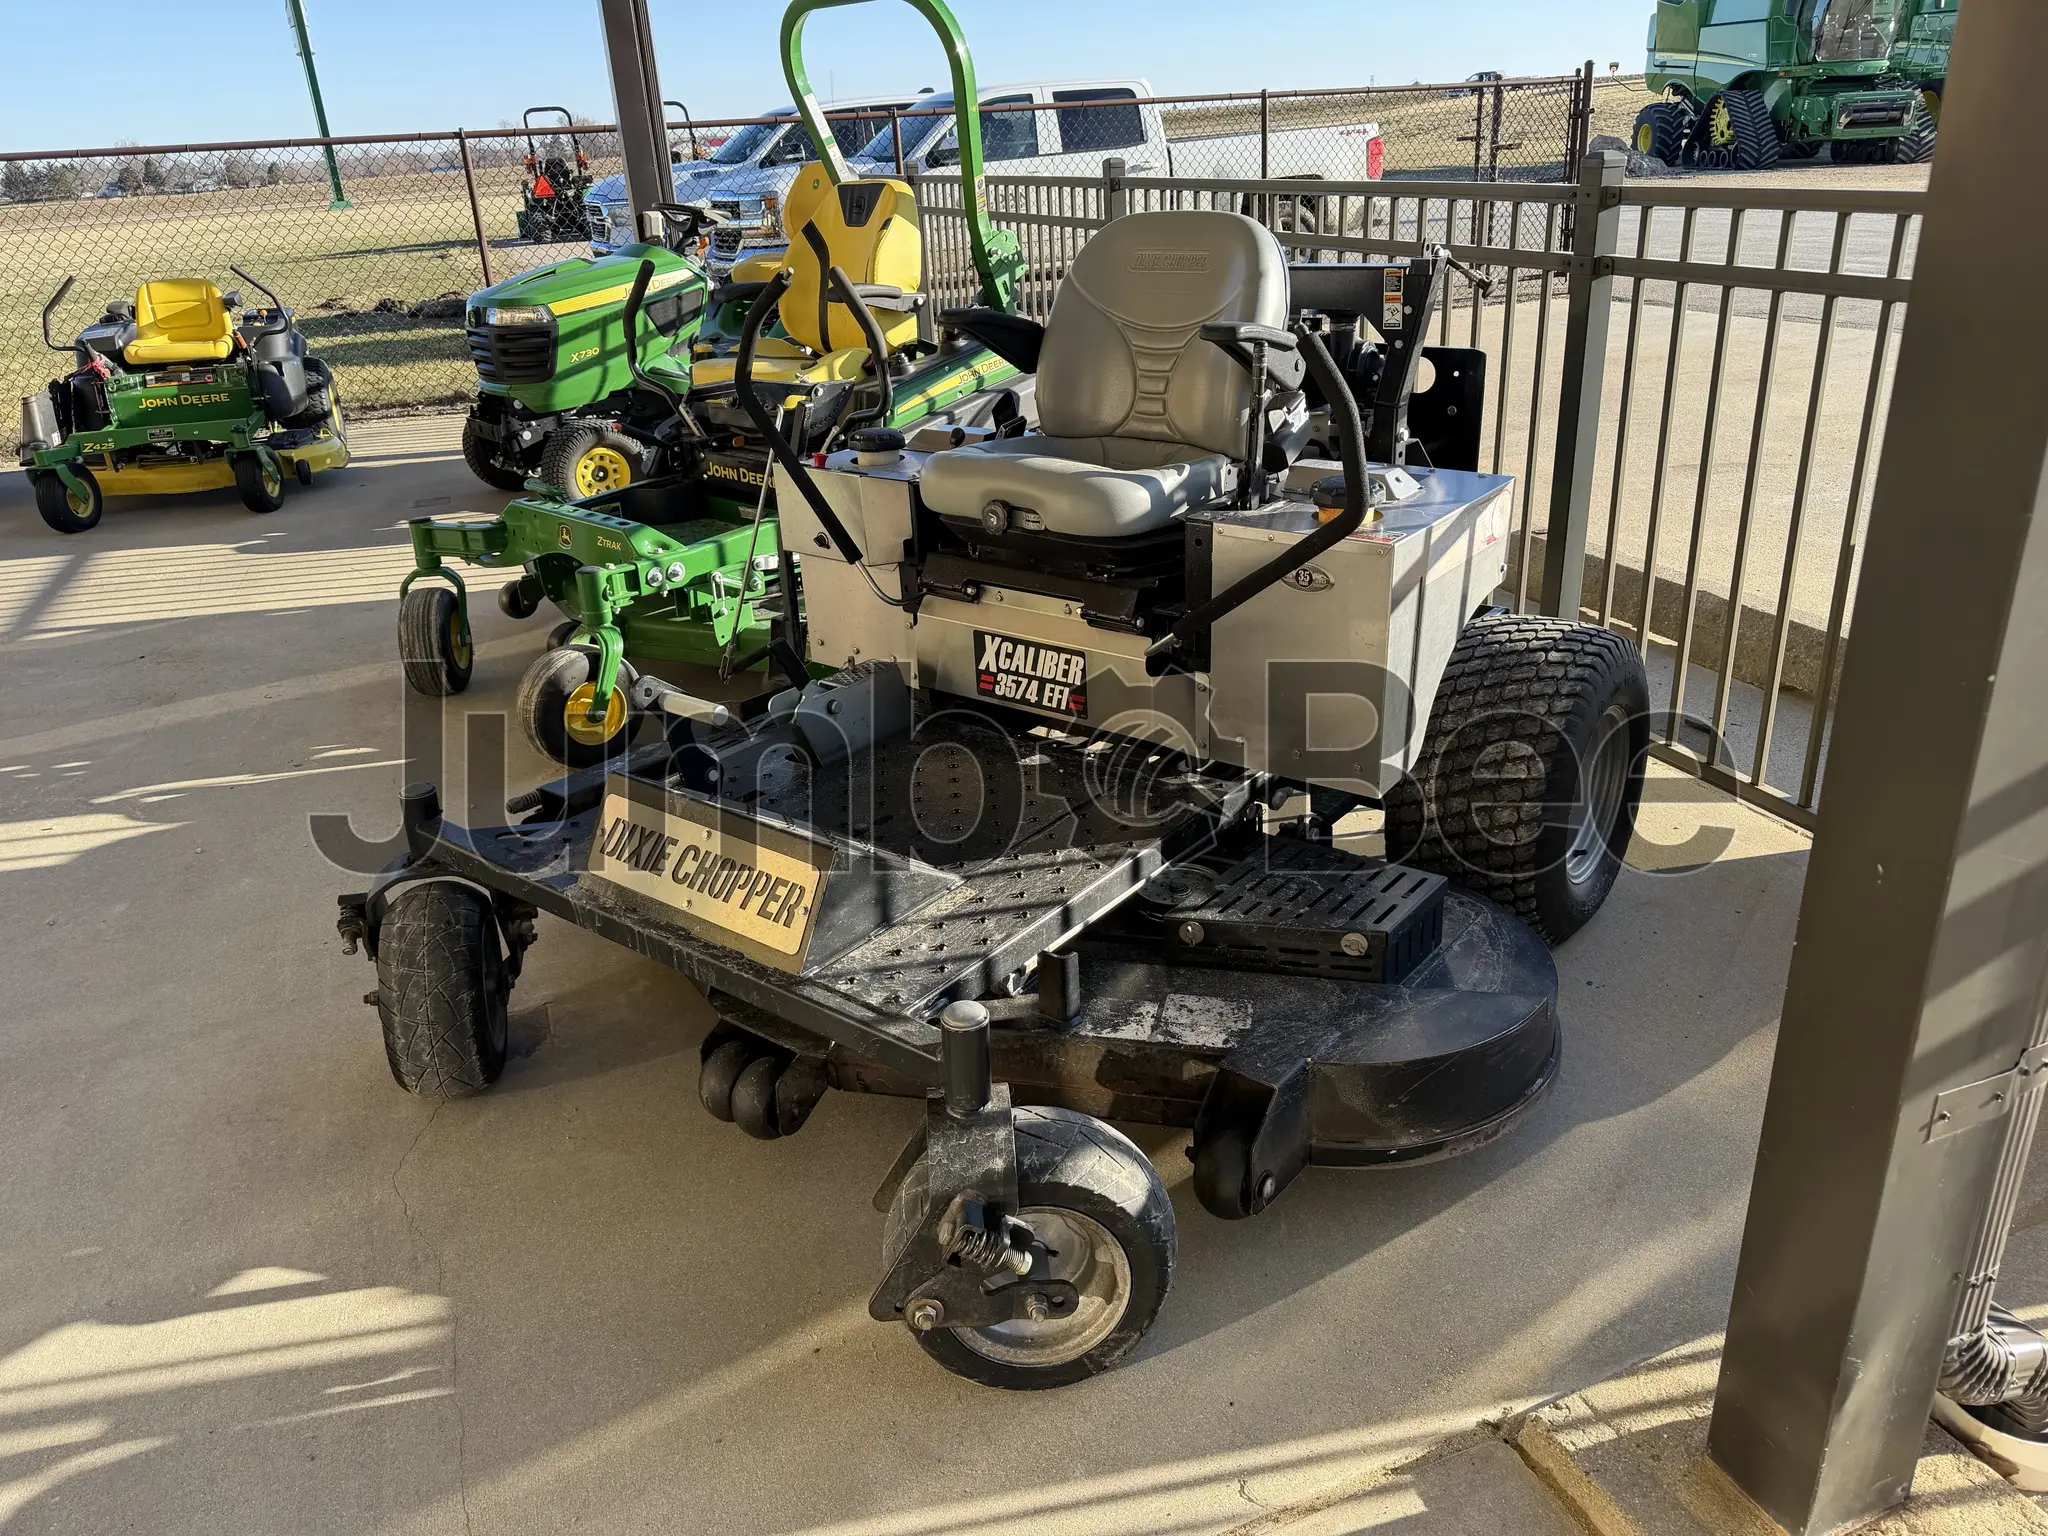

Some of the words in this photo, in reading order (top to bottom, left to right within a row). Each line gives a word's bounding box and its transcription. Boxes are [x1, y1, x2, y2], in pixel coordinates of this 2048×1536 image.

[570, 347, 600, 363] X730
[959, 368, 981, 384] JOHN
[981, 359, 1008, 373] DEER
[139, 397, 178, 409] JOHN
[180, 393, 230, 405] DEERE
[82, 442, 115, 453] Z425
[707, 461, 738, 481] JOHN
[597, 535, 622, 551] ZTRAK
[1298, 570, 1310, 582] 35
[978, 634, 1085, 686] XCALIBER
[995, 673, 1039, 704] 3574
[1042, 683, 1070, 710] EFI
[598, 817, 679, 877] DIXIE
[671, 844, 806, 929] CHOPPER
